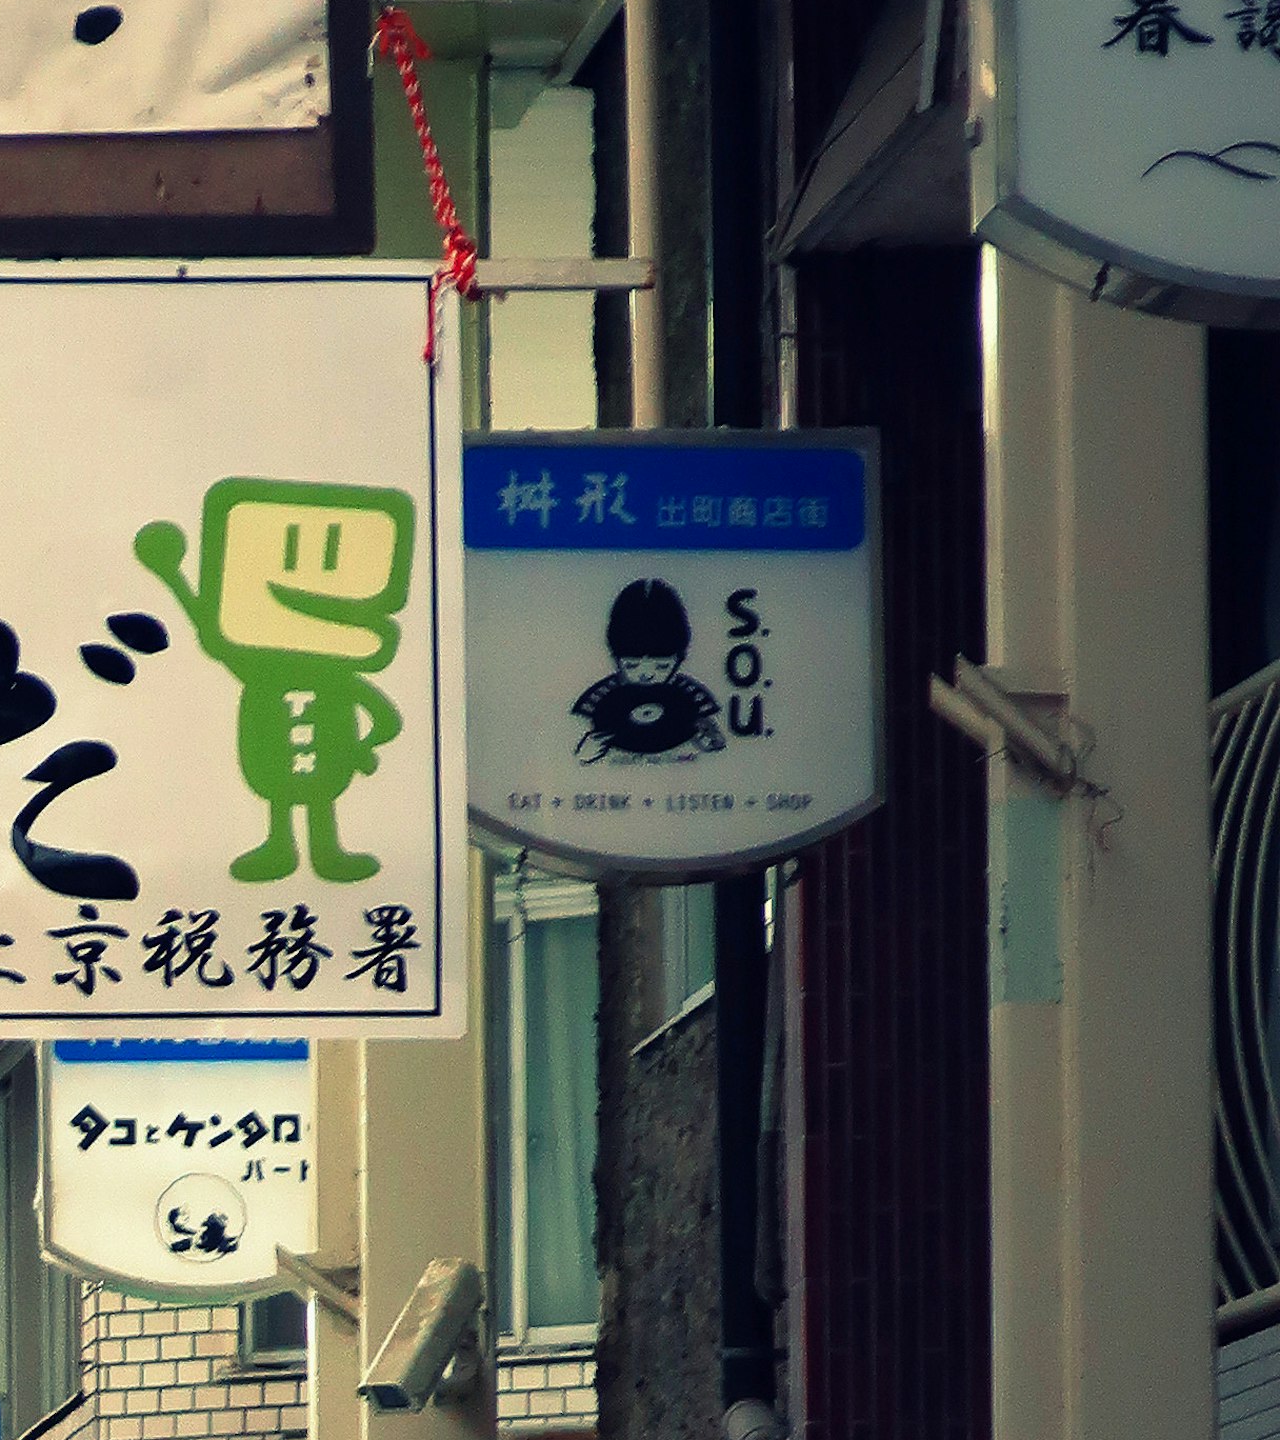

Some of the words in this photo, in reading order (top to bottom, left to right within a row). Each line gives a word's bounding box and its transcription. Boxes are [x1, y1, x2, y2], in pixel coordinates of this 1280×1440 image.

[69, 1103, 310, 1153] タコとケンタロ
